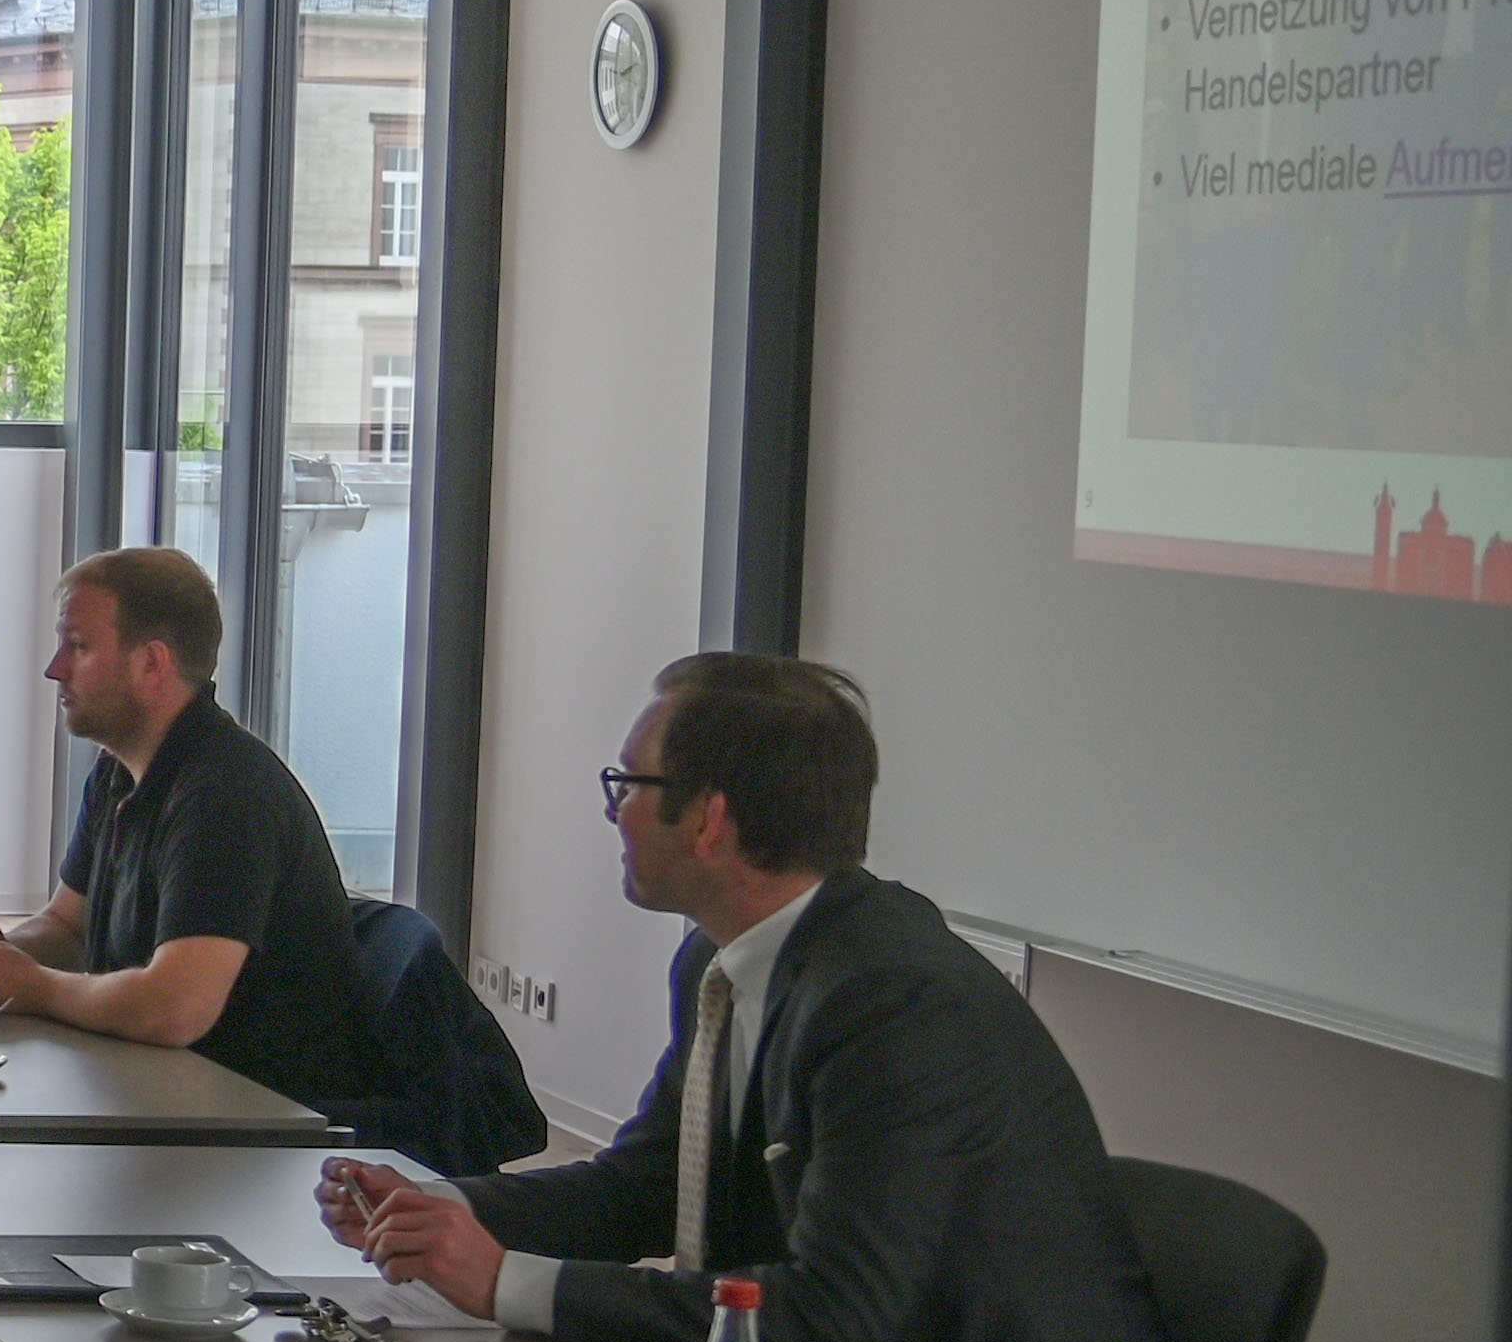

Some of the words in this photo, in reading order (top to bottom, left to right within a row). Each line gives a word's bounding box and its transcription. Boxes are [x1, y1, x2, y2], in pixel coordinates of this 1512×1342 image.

[1184, 52, 1441, 113] Handelspartner
[1181, 152, 1236, 198] Viel
[1246, 143, 1377, 195] mediale
[1384, 136, 1512, 191] Aufme
